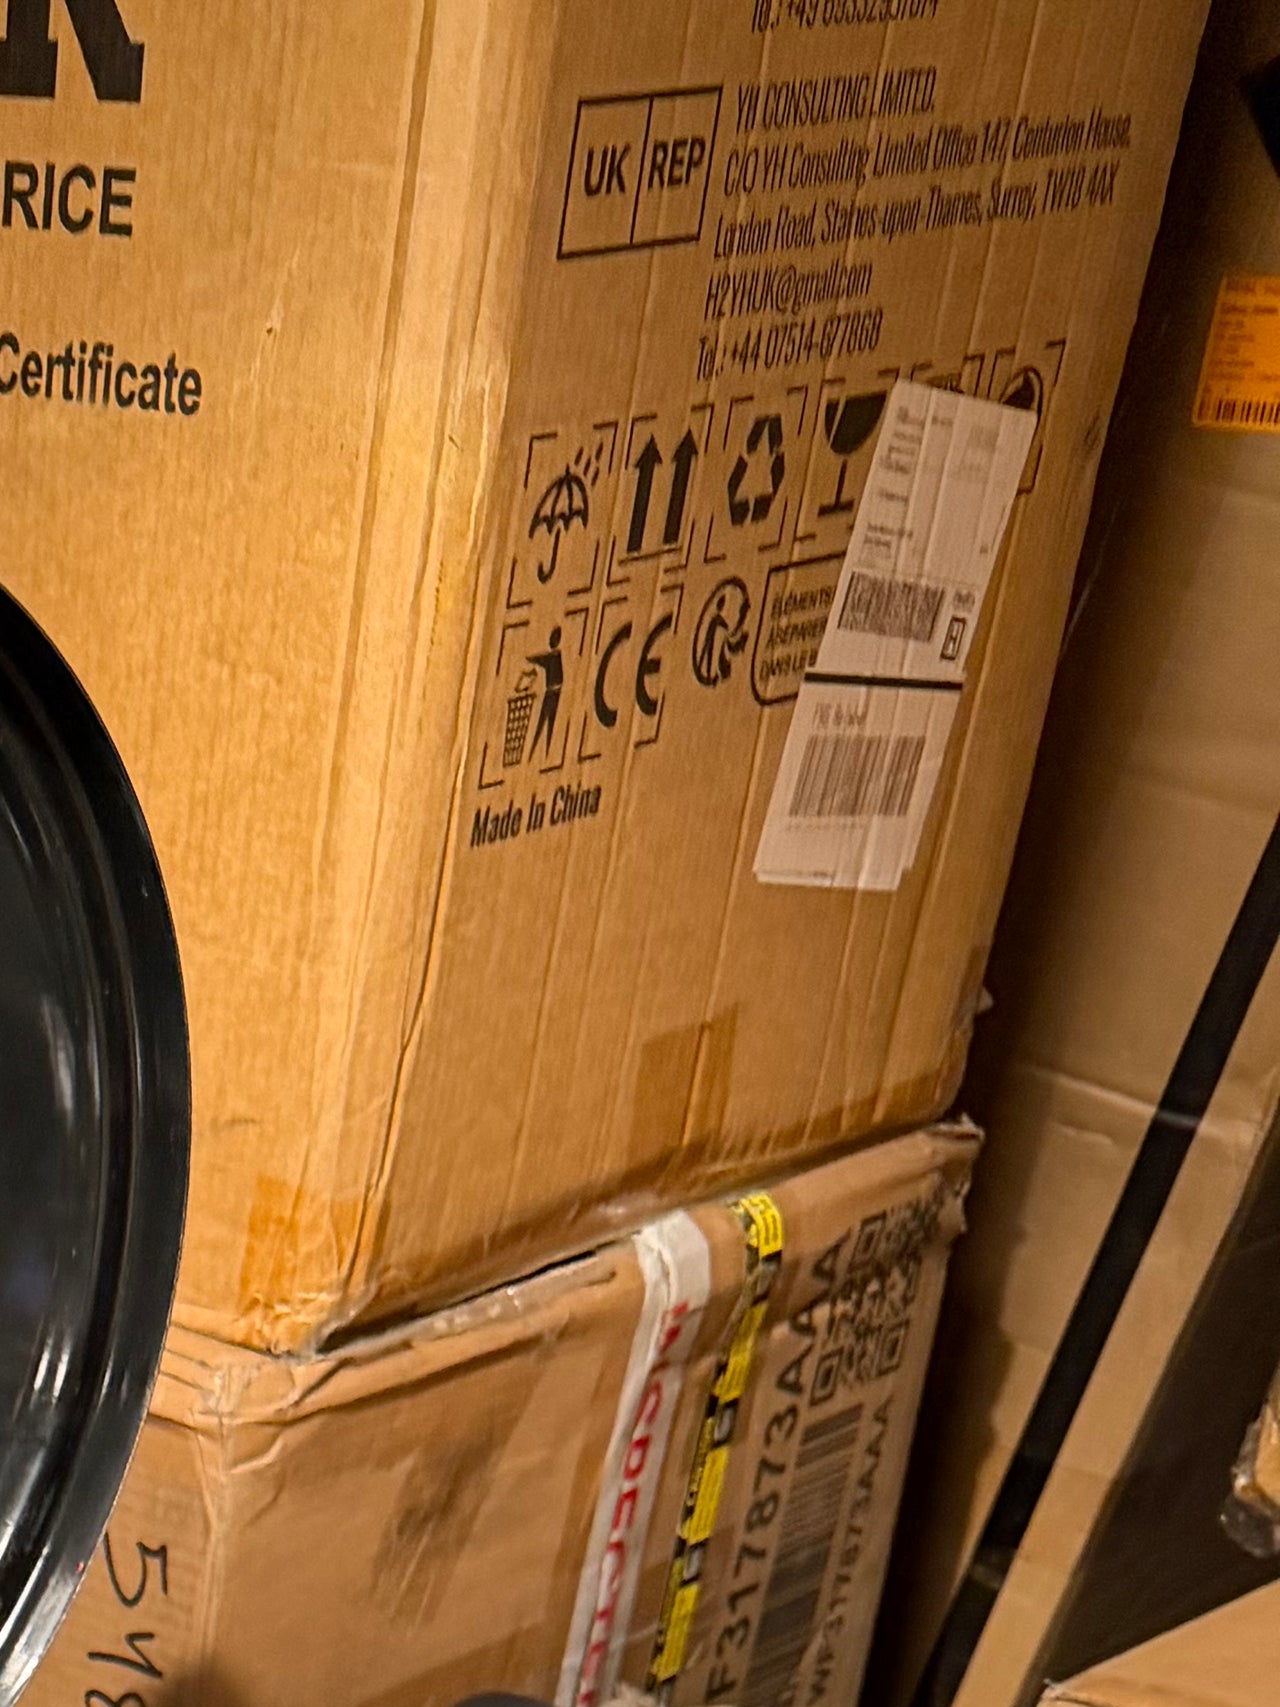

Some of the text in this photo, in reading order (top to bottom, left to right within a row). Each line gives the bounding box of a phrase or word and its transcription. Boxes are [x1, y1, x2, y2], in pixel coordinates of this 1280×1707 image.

[762, 72, 870, 132] CONSULTING
[583, 136, 707, 197] UK REP
[723, 142, 758, 198] C/O
[762, 138, 788, 192] YH
[873, 124, 937, 180] Limited
[1012, 111, 1085, 162] Centurion
[713, 211, 771, 262] London
[771, 205, 817, 252] Road,
[730, 331, 761, 374] +44
[469, 805, 523, 850] Made
[549, 780, 602, 830] China
[707, 1226, 851, 1702] F317873AAA
